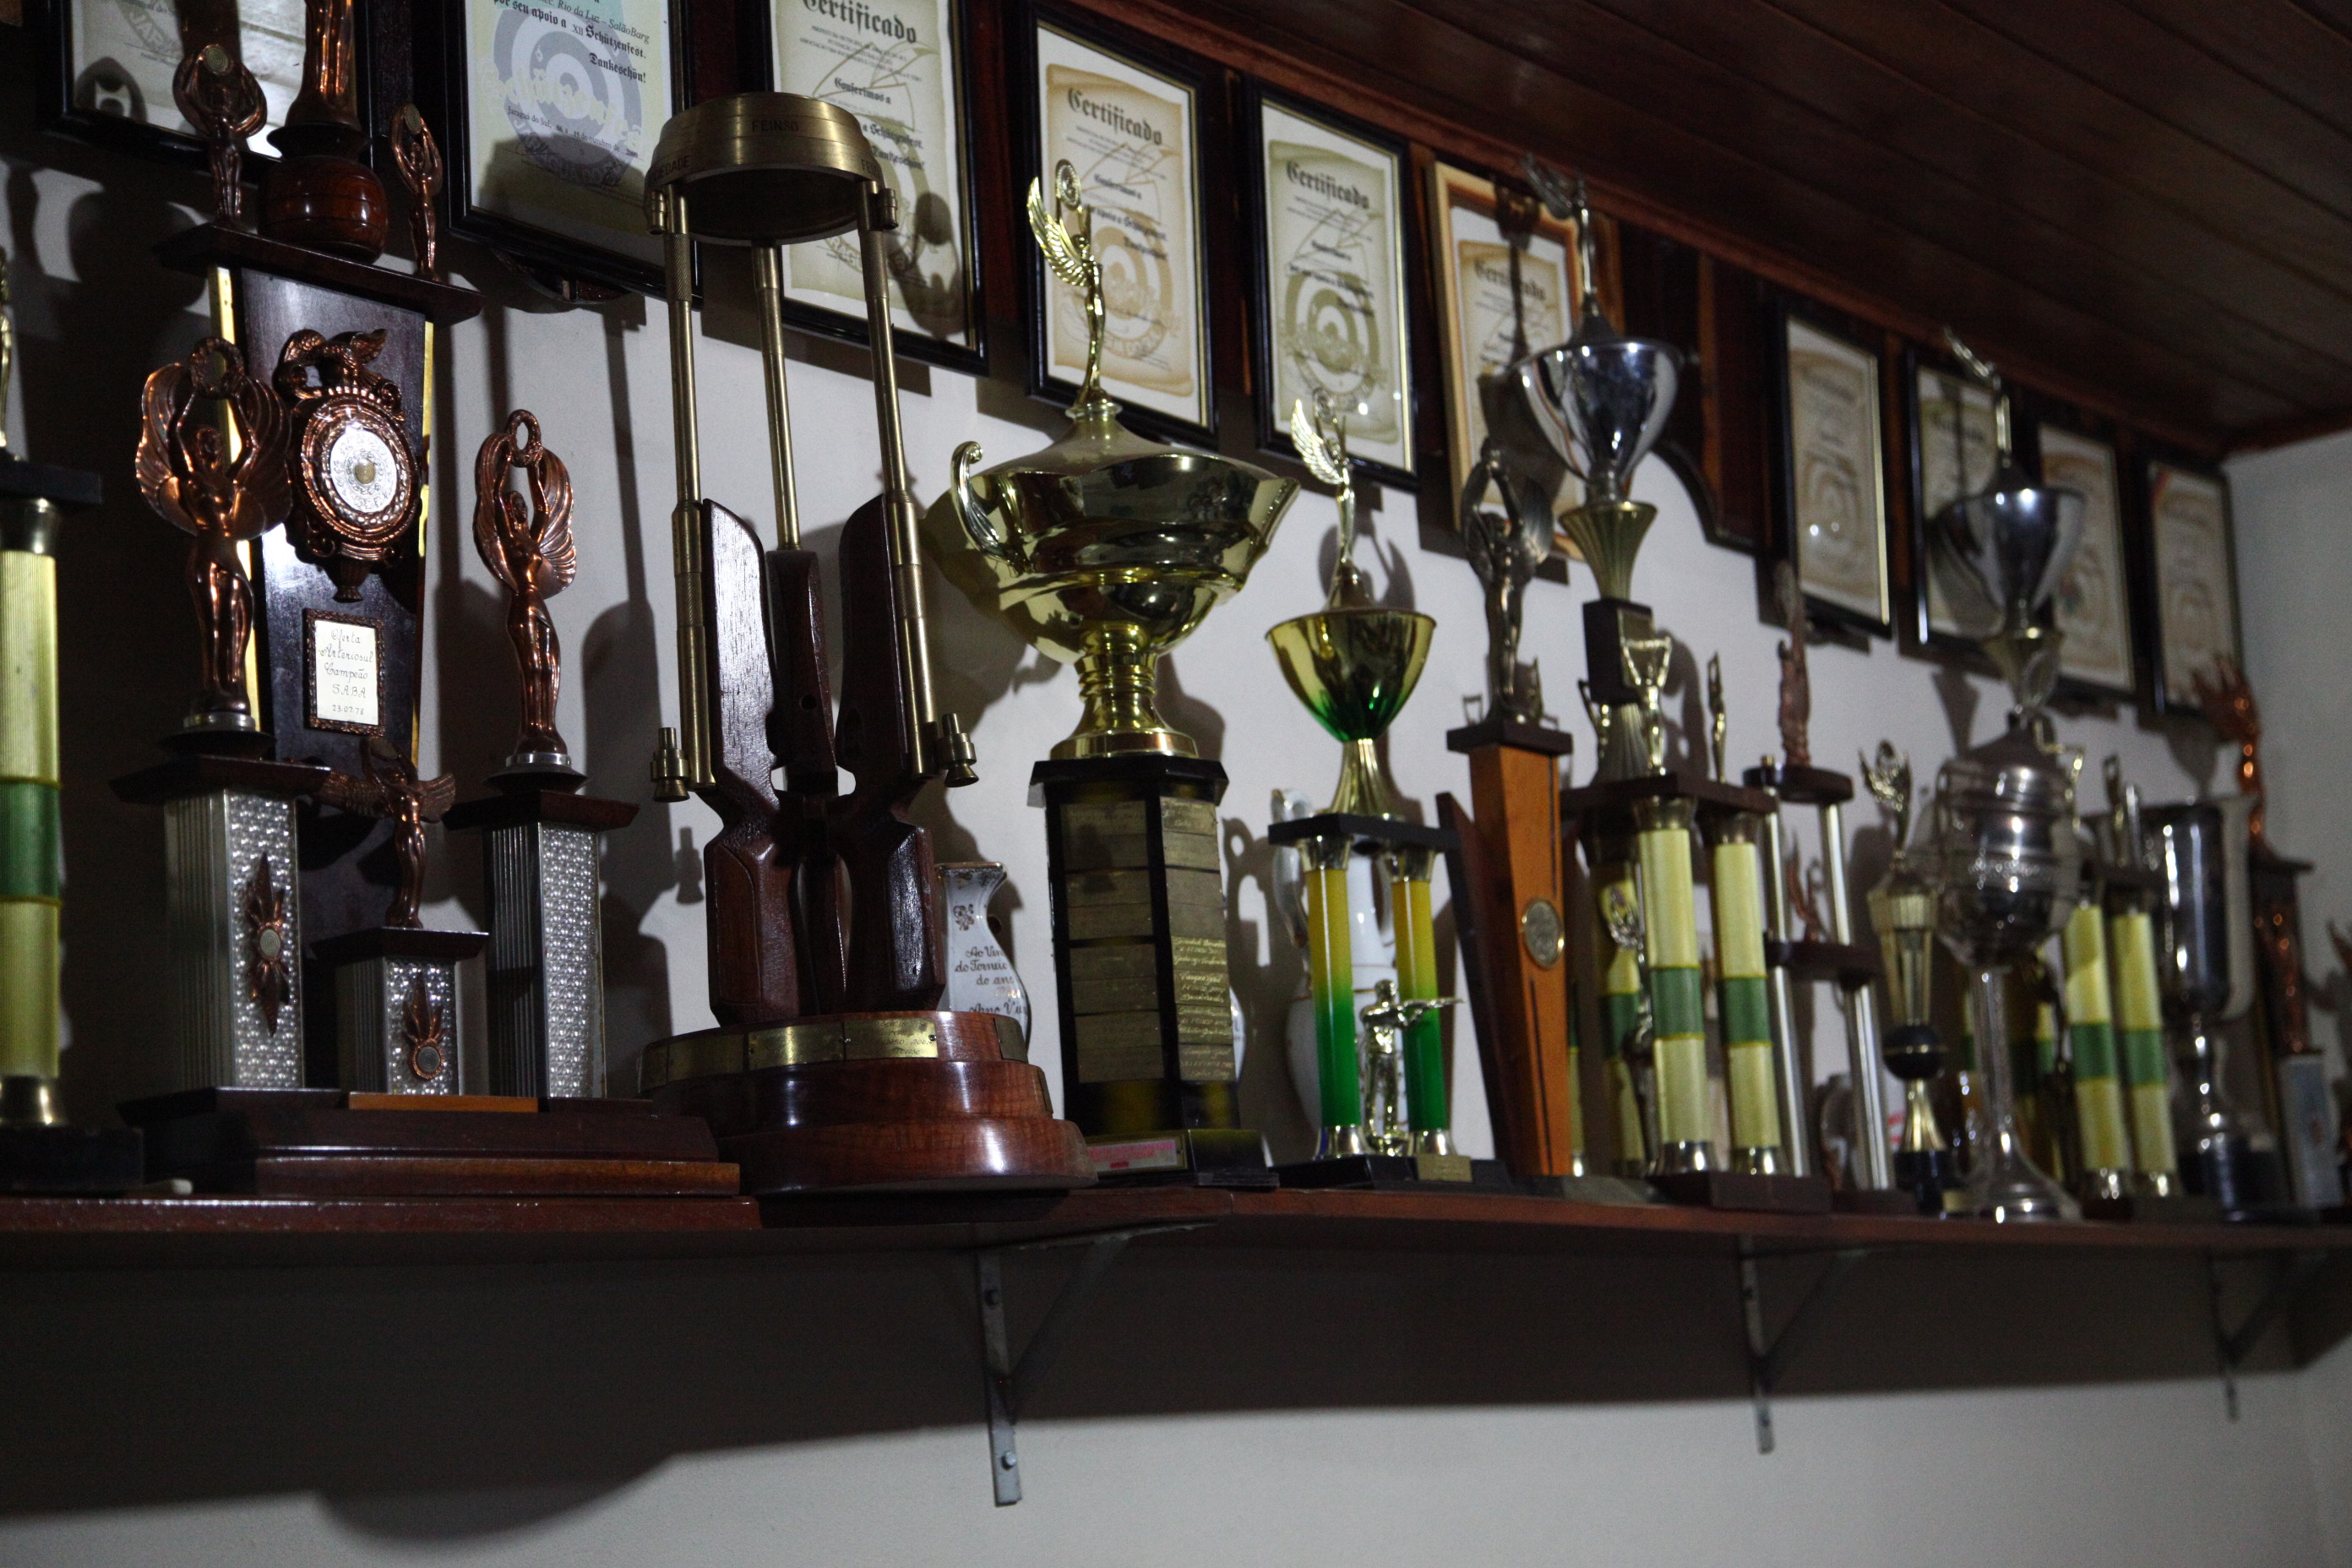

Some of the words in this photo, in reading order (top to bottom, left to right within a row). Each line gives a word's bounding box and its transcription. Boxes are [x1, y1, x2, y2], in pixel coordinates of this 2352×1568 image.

[558, 0, 571, 13] Rio
[574, 5, 583, 18] da
[512, 0, 529, 14] seu
[531, 8, 558, 25] apoio
[561, 19, 566, 28] a
[585, 23, 646, 58] Schützenfest.
[589, 52, 646, 84] Dankeschön!
[531, 113, 539, 123] do
[1068, 87, 1162, 145] Certificado
[752, 120, 799, 133] FEINSO
[330, 629, 362, 651] Oferta
[324, 662, 368, 683] Campeão
[331, 683, 366, 699] SABA
[966, 946, 983, 958] Ao
[955, 961, 969, 972] do
[976, 974, 989, 986] do
